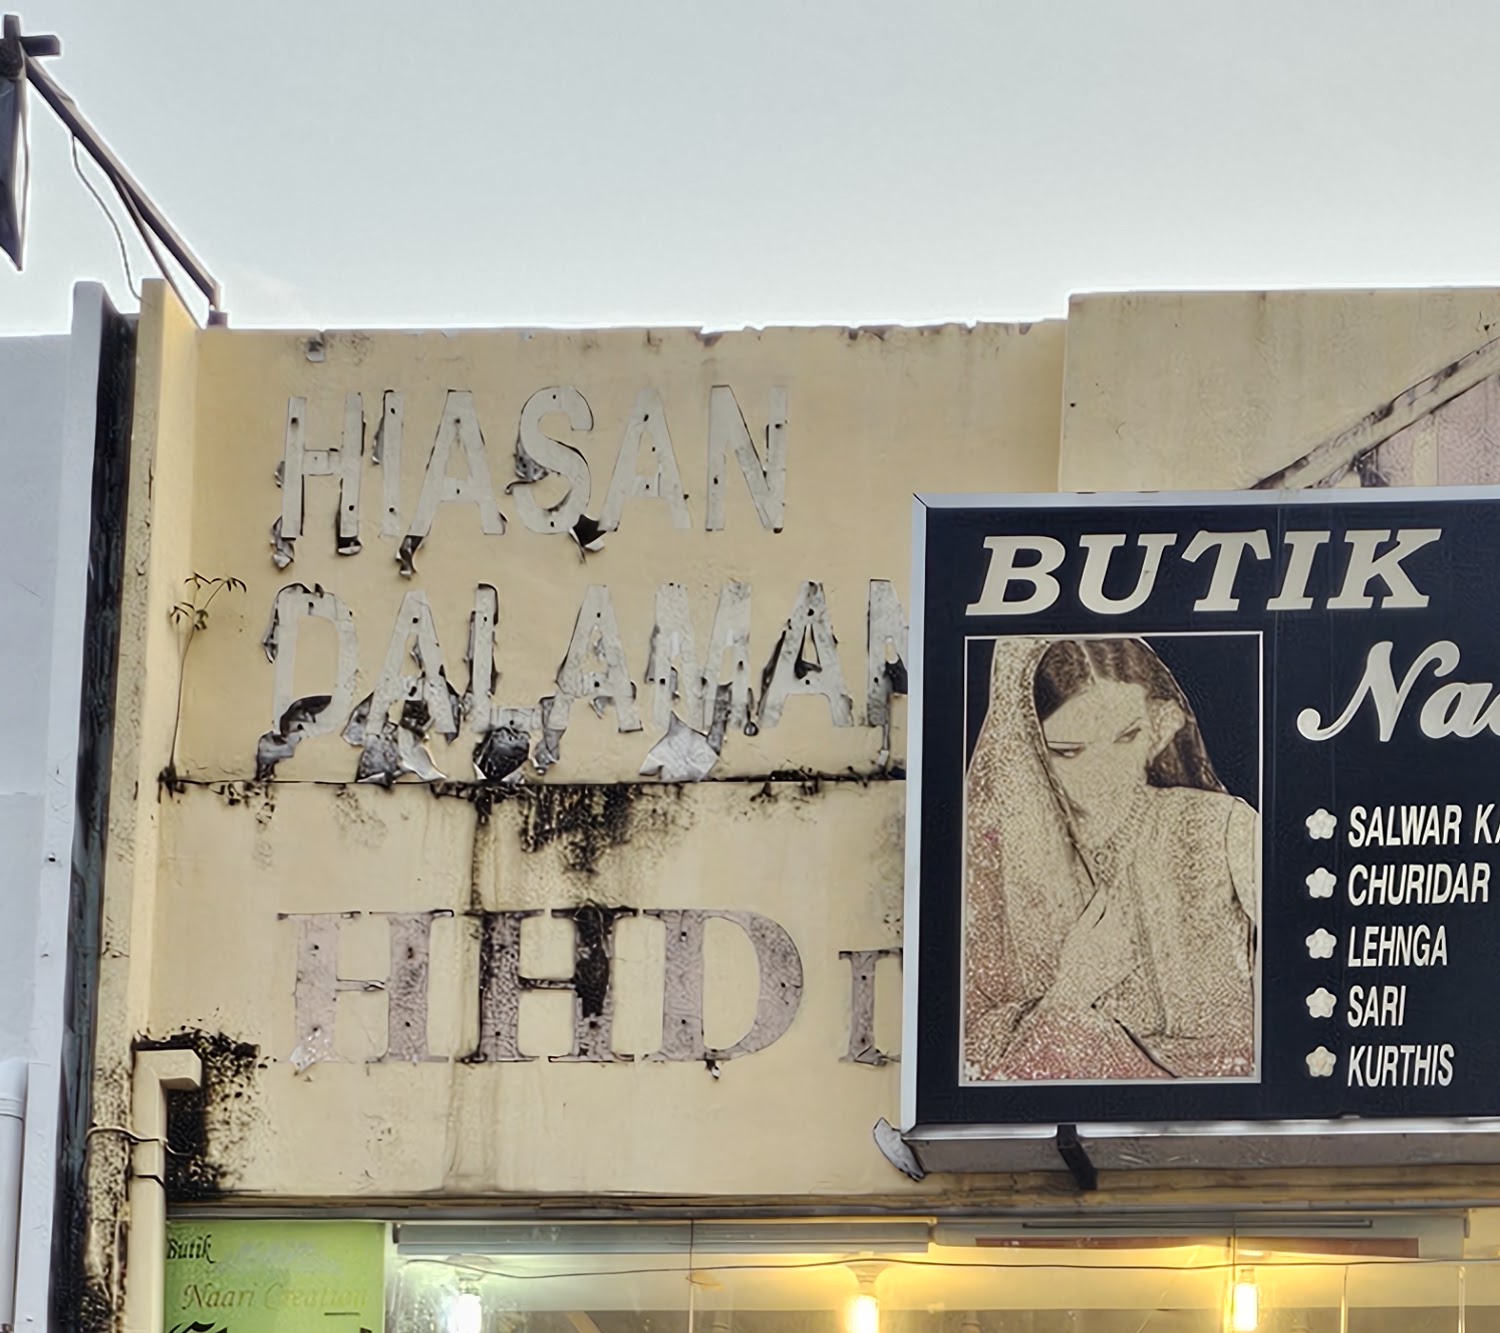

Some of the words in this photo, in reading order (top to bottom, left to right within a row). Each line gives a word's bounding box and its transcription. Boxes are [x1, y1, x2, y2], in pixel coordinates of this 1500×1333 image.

[283, 385, 788, 538] HIASAN
[966, 529, 1441, 615] BUTIK
[1348, 805, 1462, 846] SALWAR
[1348, 863, 1491, 905] CHURIDAR
[1348, 926, 1447, 967] LEHNGA
[1347, 986, 1406, 1027] SARI
[1348, 1044, 1454, 1087] KURTHIS
[181, 1283, 257, 1310] Naari
